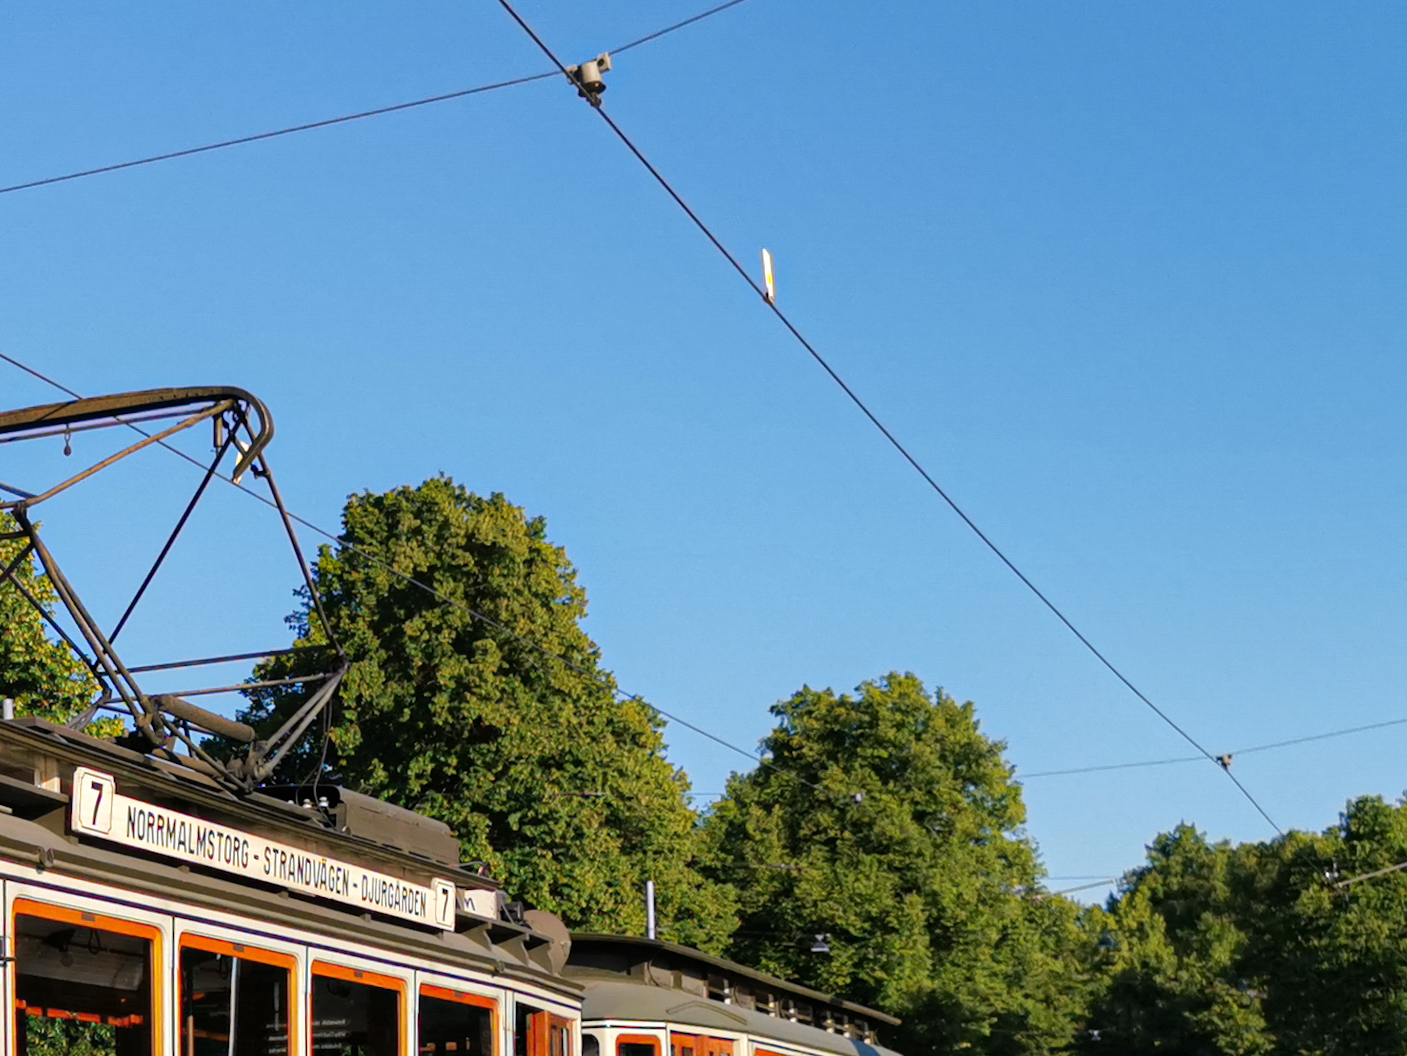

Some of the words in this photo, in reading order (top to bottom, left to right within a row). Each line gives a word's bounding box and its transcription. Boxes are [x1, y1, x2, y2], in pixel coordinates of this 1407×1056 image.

[90, 780, 104, 826] 7
[126, 805, 250, 869] NORRMALMSTORG
[263, 846, 350, 897] STRANDVÄGEN
[361, 873, 427, 918] DJURGÅRDEN
[442, 887, 449, 922] 7
